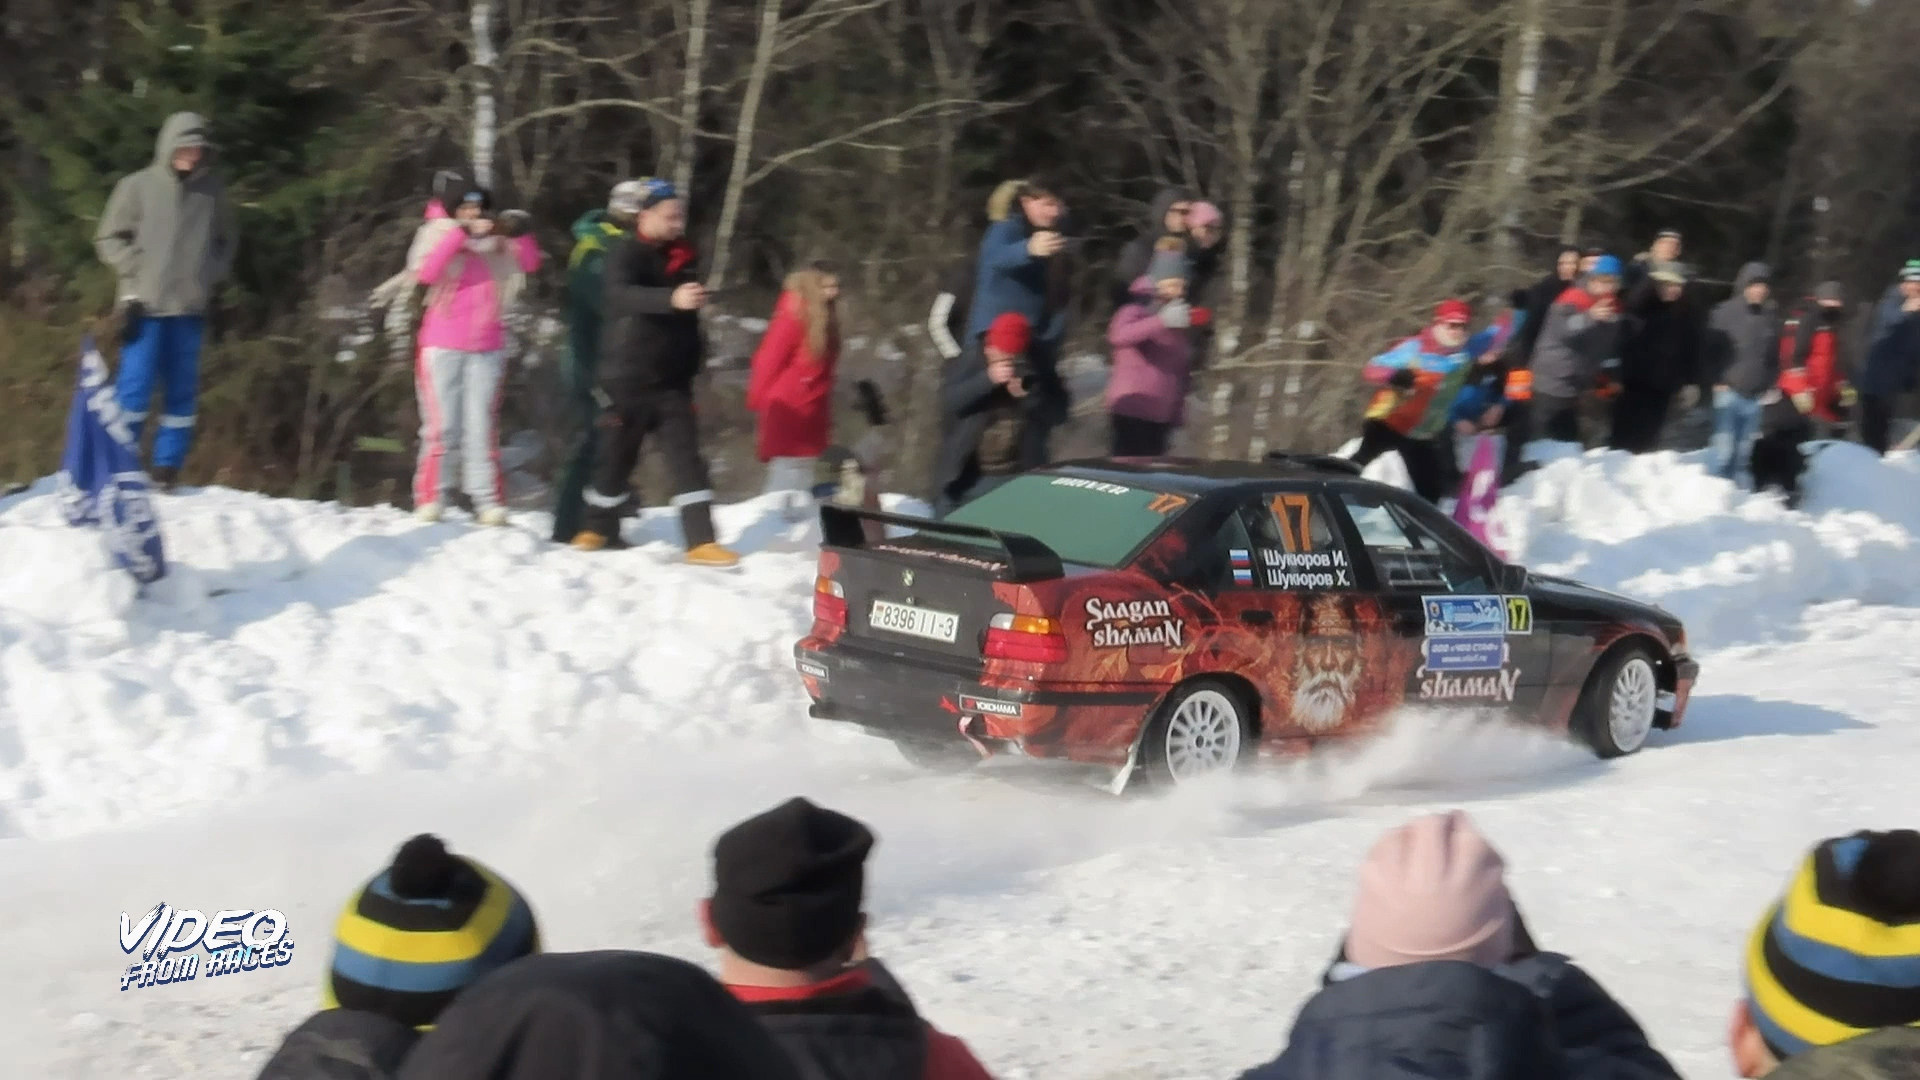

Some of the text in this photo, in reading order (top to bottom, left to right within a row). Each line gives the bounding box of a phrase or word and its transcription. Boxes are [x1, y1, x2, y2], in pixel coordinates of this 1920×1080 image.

[1148, 493, 1187, 514] 17
[1270, 494, 1312, 552] 17
[1263, 549, 1348, 570] Шукюров И.
[1267, 569, 1351, 590] Шукюров Х.
[883, 605, 917, 630] 8396
[1085, 597, 1171, 630] Saagan
[1508, 598, 1528, 630] 17
[975, 701, 1017, 715] YOKOHAMA
